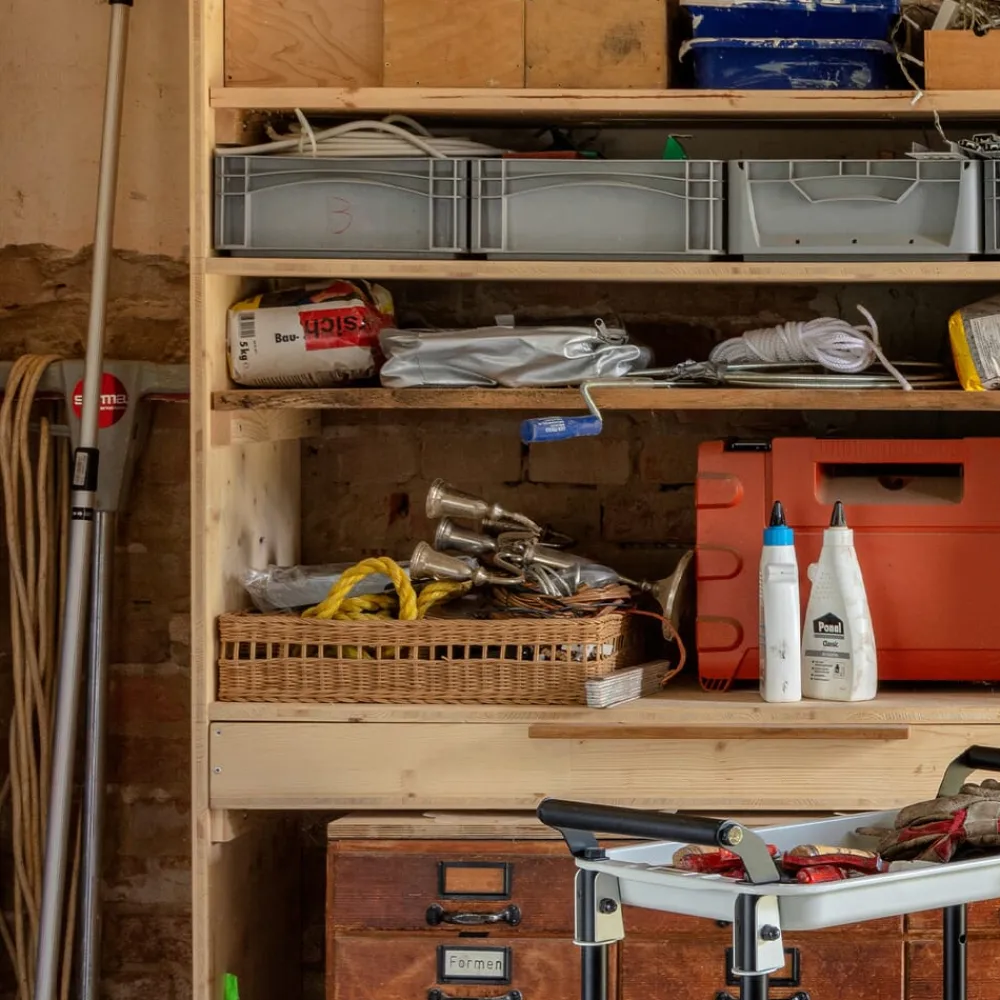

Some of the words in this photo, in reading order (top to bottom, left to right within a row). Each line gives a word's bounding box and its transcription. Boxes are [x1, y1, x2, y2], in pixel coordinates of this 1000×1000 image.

[73, 393, 127, 406] sma
[818, 621, 842, 634] Ponal
[449, 955, 502, 971] Formen
